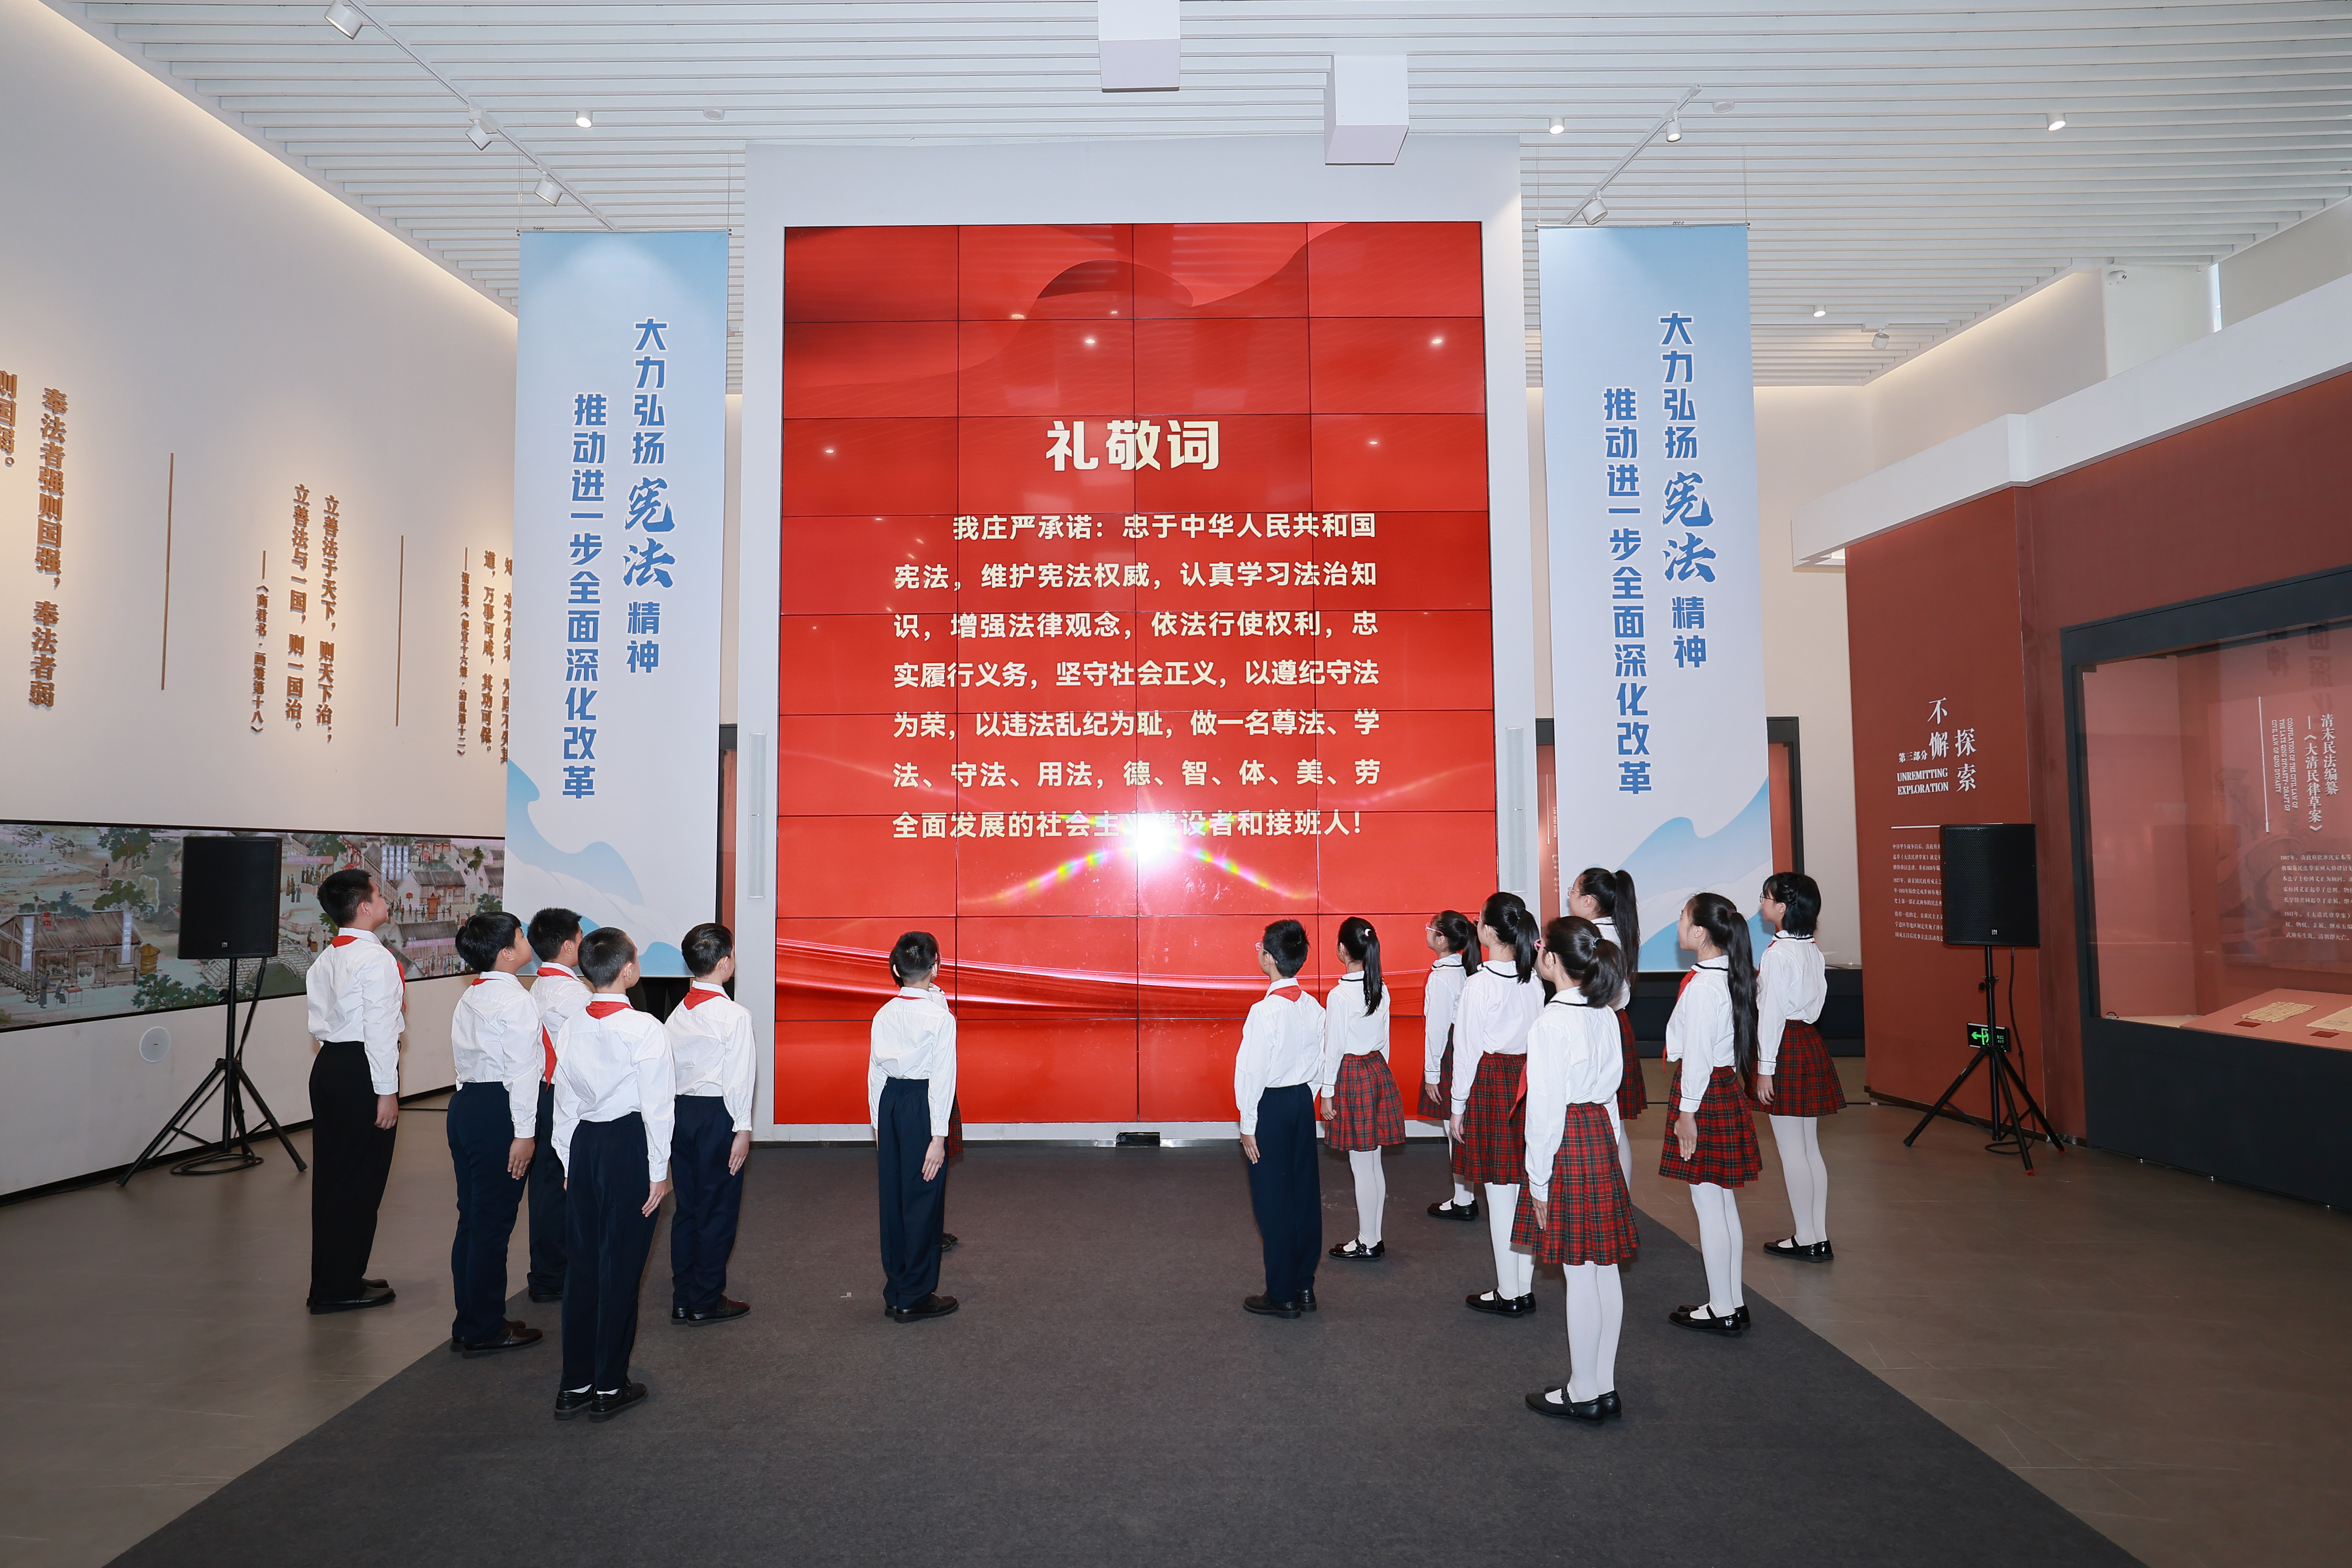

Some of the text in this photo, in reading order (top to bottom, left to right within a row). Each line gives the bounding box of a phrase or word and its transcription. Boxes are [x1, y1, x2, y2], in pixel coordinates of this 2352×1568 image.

[1046, 420, 1219, 471] 礼敬词
[624, 319, 675, 673] 大力弘扬宪法精神
[1661, 313, 1716, 668] 大力弘扬宪法精神
[953, 513, 1376, 540] 我庄严承诺：忠于中华人民共和国
[895, 561, 1376, 590] 宪法，维护宪法权威，认真学习法治知
[563, 394, 606, 799] 推动进一步全面深化改革
[1604, 388, 1651, 794] 推动进一步全面深化改革
[894, 611, 1378, 641] 识，增强法律观念，依法行使权利，忠
[894, 659, 1379, 689] 实履行义务，坚守社会正义，以遵纪守法
[893, 710, 1380, 740] 为荣，以违法乱纪为耻，做一名尊法、学
[1898, 750, 1928, 763] 第三部分
[2321, 713, 2339, 795] 清末民法编纂
[893, 759, 1381, 789] 法、守法、用法，德、智、体、美、劳
[1896, 768, 1948, 782] UNREMITTING
[1897, 782, 1949, 795] EXPLORATION
